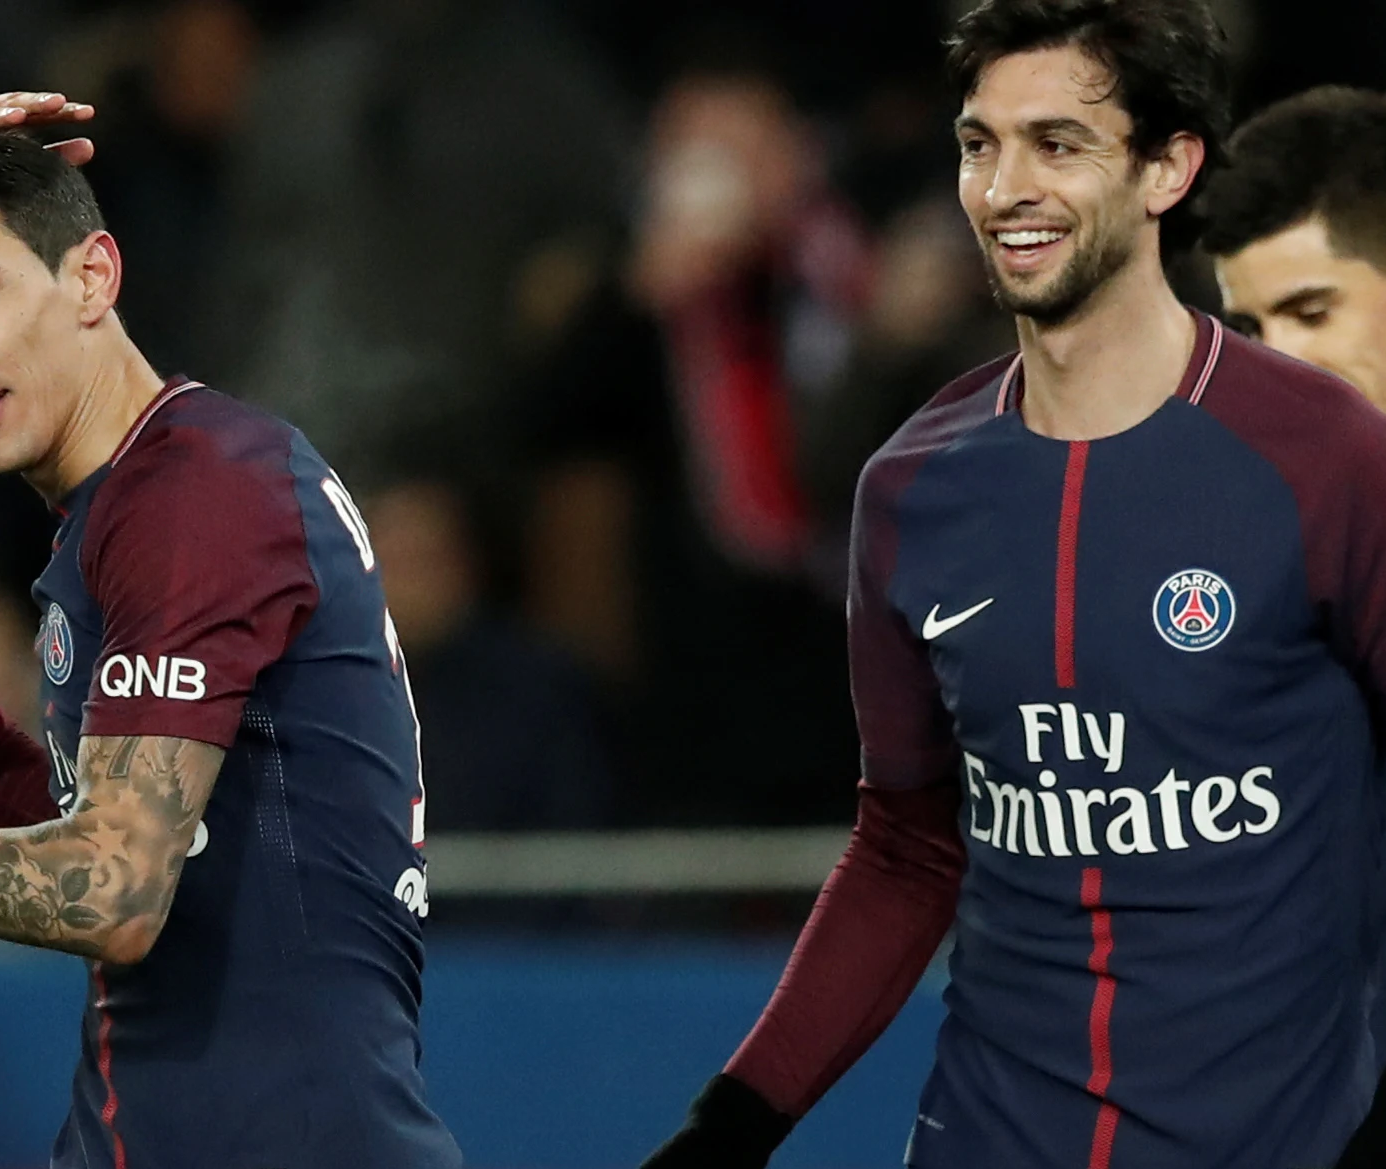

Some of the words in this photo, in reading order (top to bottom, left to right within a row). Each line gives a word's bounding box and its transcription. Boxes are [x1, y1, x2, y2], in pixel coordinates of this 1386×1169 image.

[1167, 574, 1222, 595] PARIS
[100, 653, 207, 701] QNB
[1018, 702, 1126, 773] Fly
[963, 750, 1281, 857] Emirates
